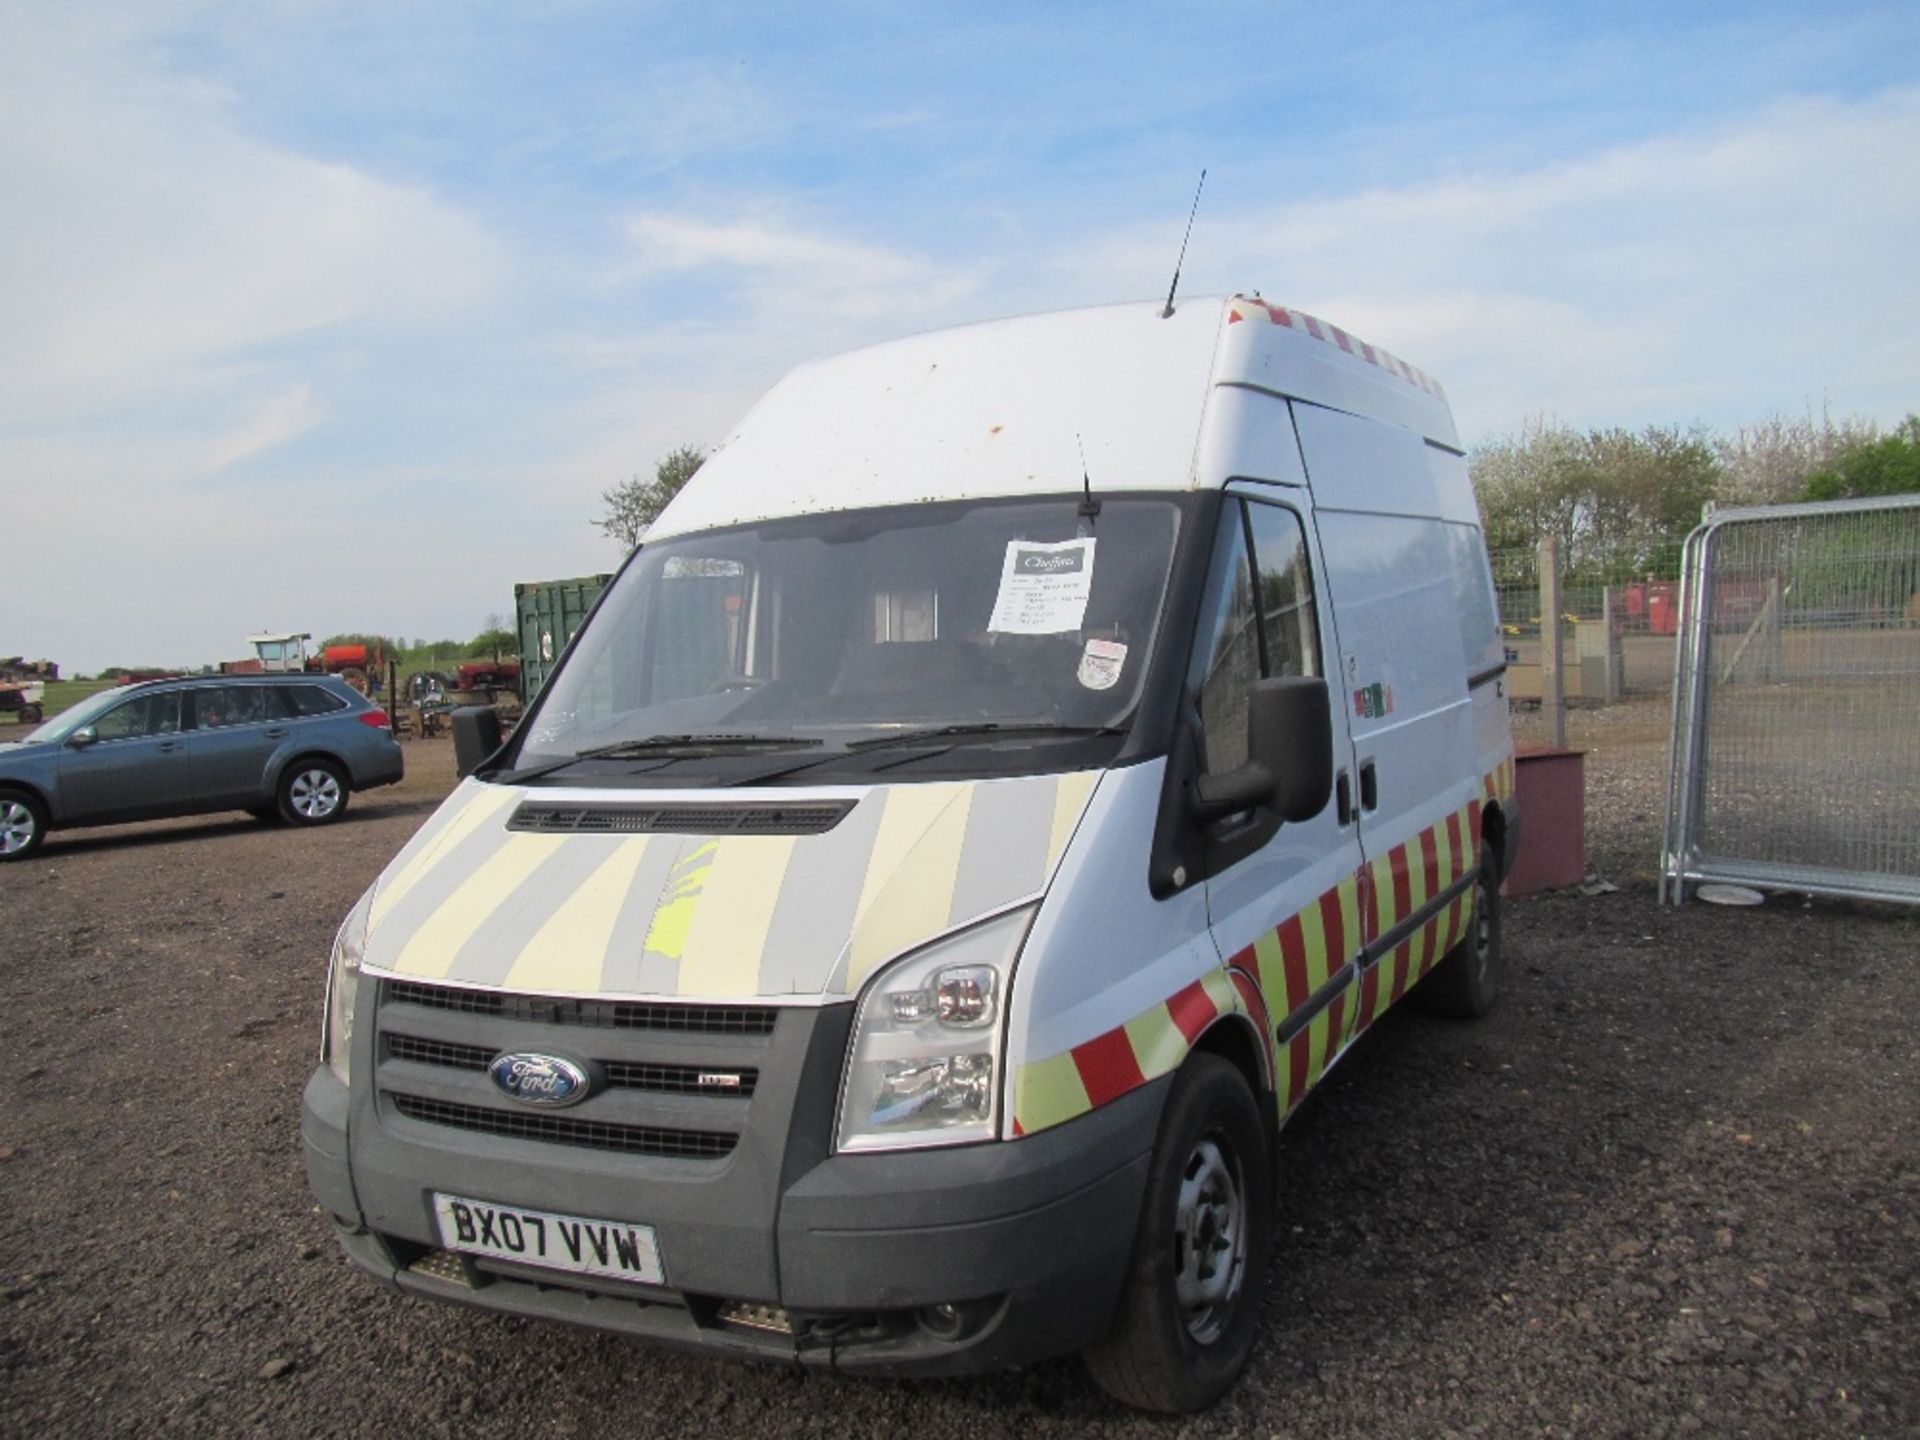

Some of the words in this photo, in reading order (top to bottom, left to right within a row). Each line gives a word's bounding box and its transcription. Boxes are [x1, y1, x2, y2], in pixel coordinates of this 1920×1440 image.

[507, 1062, 559, 1093] Ford
[451, 1201, 546, 1257] BX07
[558, 1221, 642, 1272] VVW
